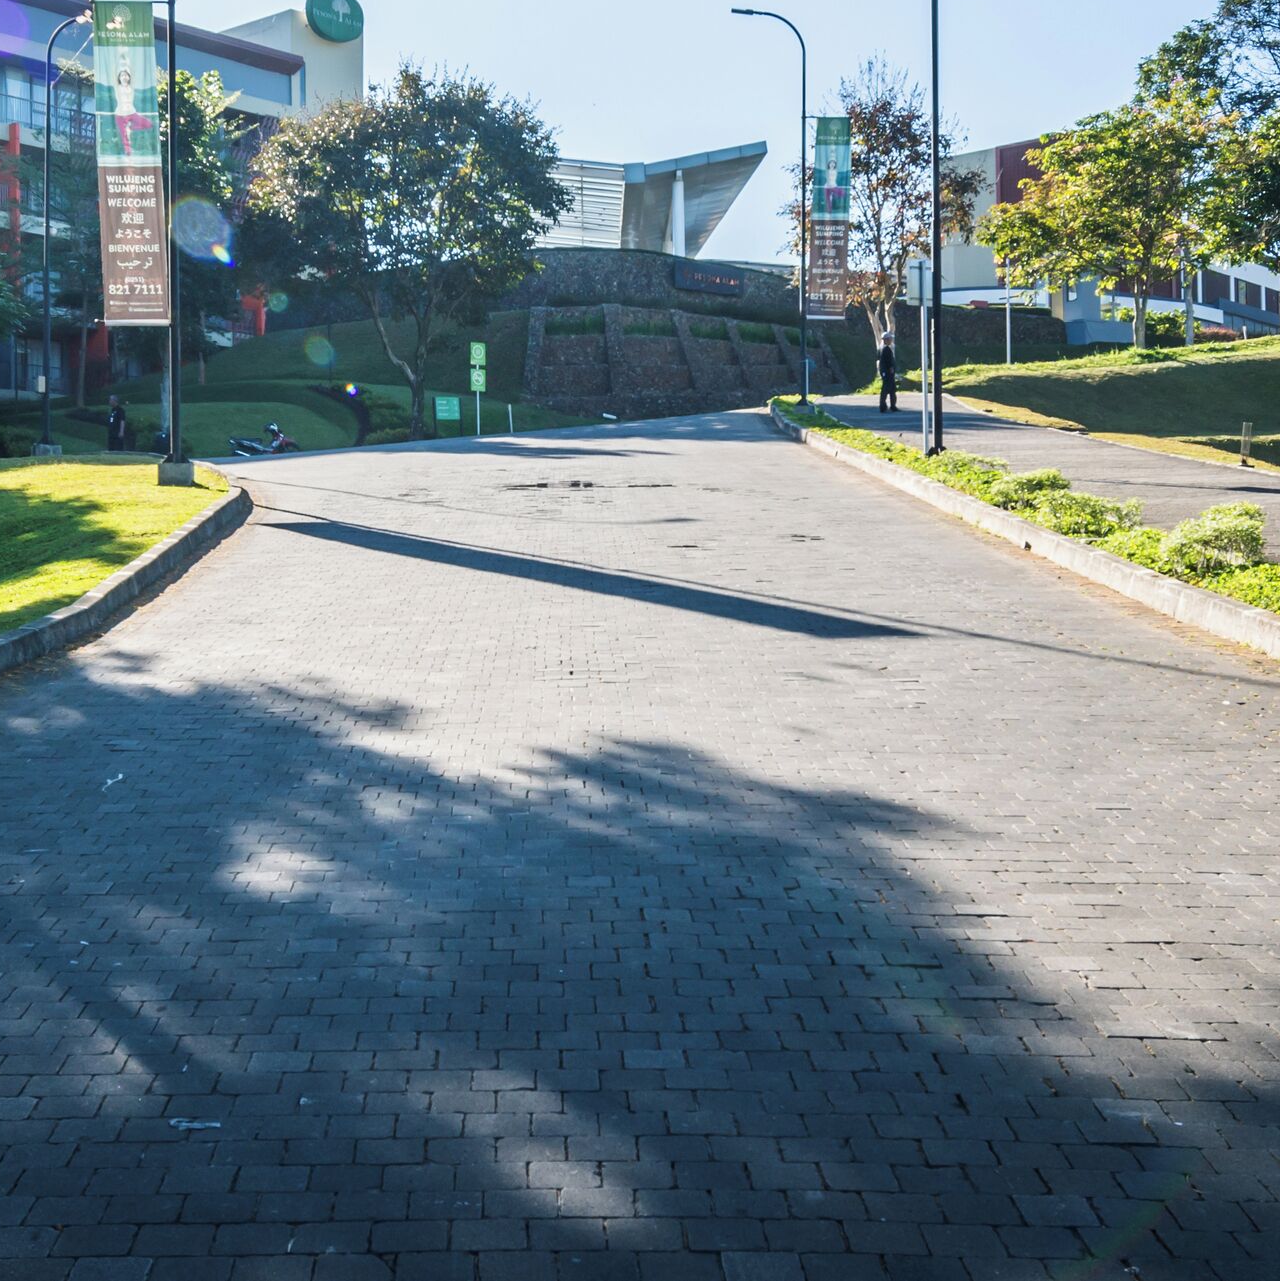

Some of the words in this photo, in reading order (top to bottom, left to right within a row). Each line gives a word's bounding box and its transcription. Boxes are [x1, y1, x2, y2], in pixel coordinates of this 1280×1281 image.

[106, 175, 155, 184] WILUJENG
[108, 184, 154, 193] SUMPING
[107, 197, 157, 208] WELCOME
[121, 212, 144, 225] 欢迎
[115, 228, 152, 239] ようこそ
[108, 244, 160, 253] BIENVENUE
[108, 284, 131, 295] 821
[133, 284, 163, 295] 7111
[825, 293, 844, 301] 7111
